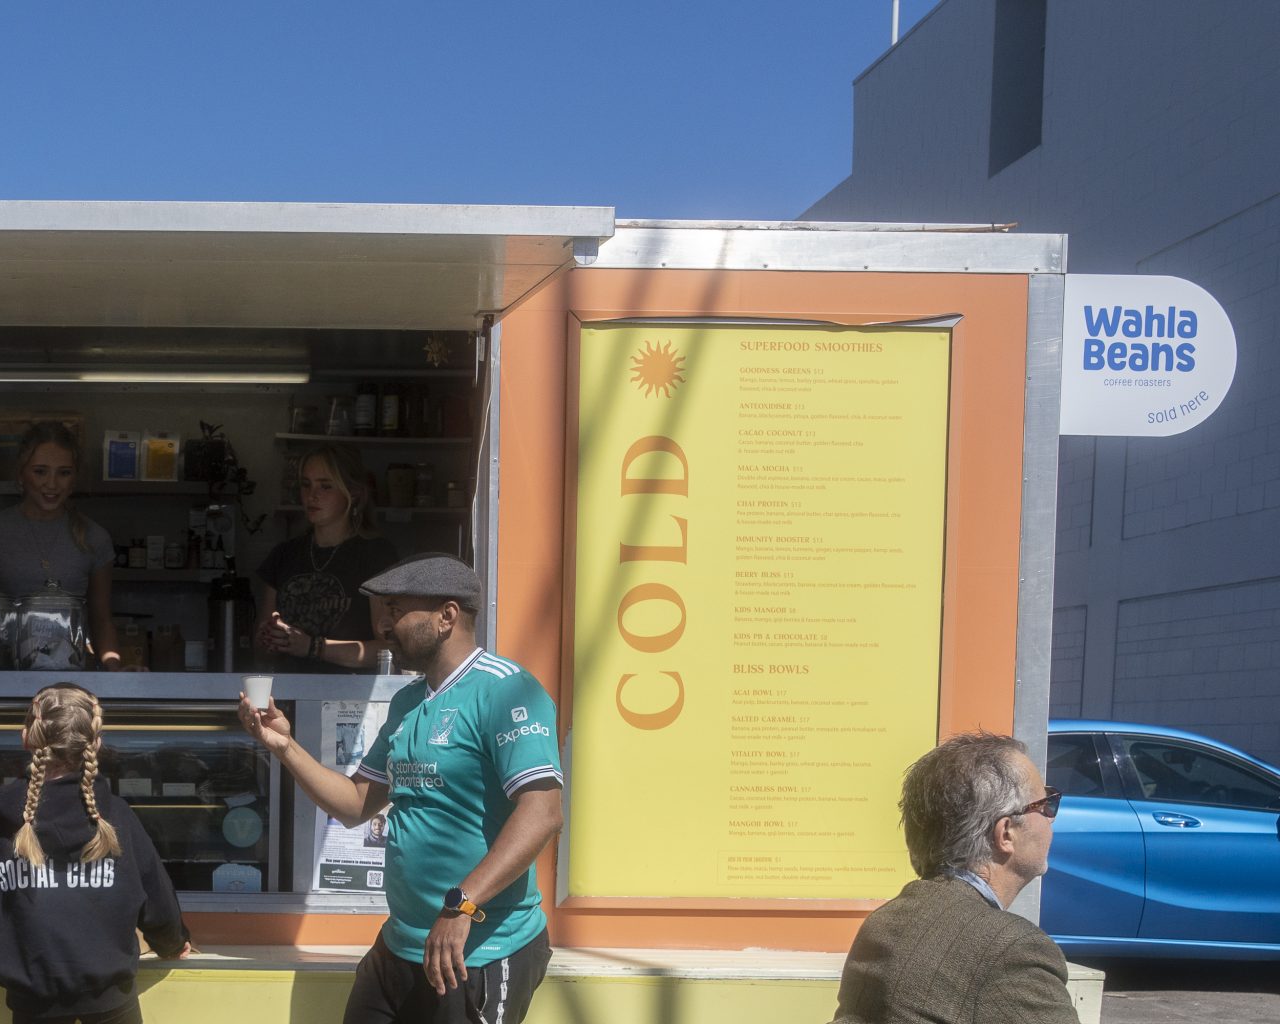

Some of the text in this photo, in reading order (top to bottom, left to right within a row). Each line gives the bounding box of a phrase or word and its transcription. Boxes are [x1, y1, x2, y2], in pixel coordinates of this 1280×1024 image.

[1084, 305, 1198, 338] Wahla
[740, 342, 883, 352] SUPERFOOD SMOOTHIES
[1083, 338, 1196, 373] Beans
[1104, 378, 1171, 387] coffee roasters
[1147, 390, 1209, 424] sold here
[616, 435, 689, 731] COLD
[734, 664, 809, 674] BLISS BOWLS
[496, 722, 550, 747] Expedia
[396, 761, 437, 774] standard
[395, 776, 445, 788] chartered
[67, 858, 115, 888] CLUB
